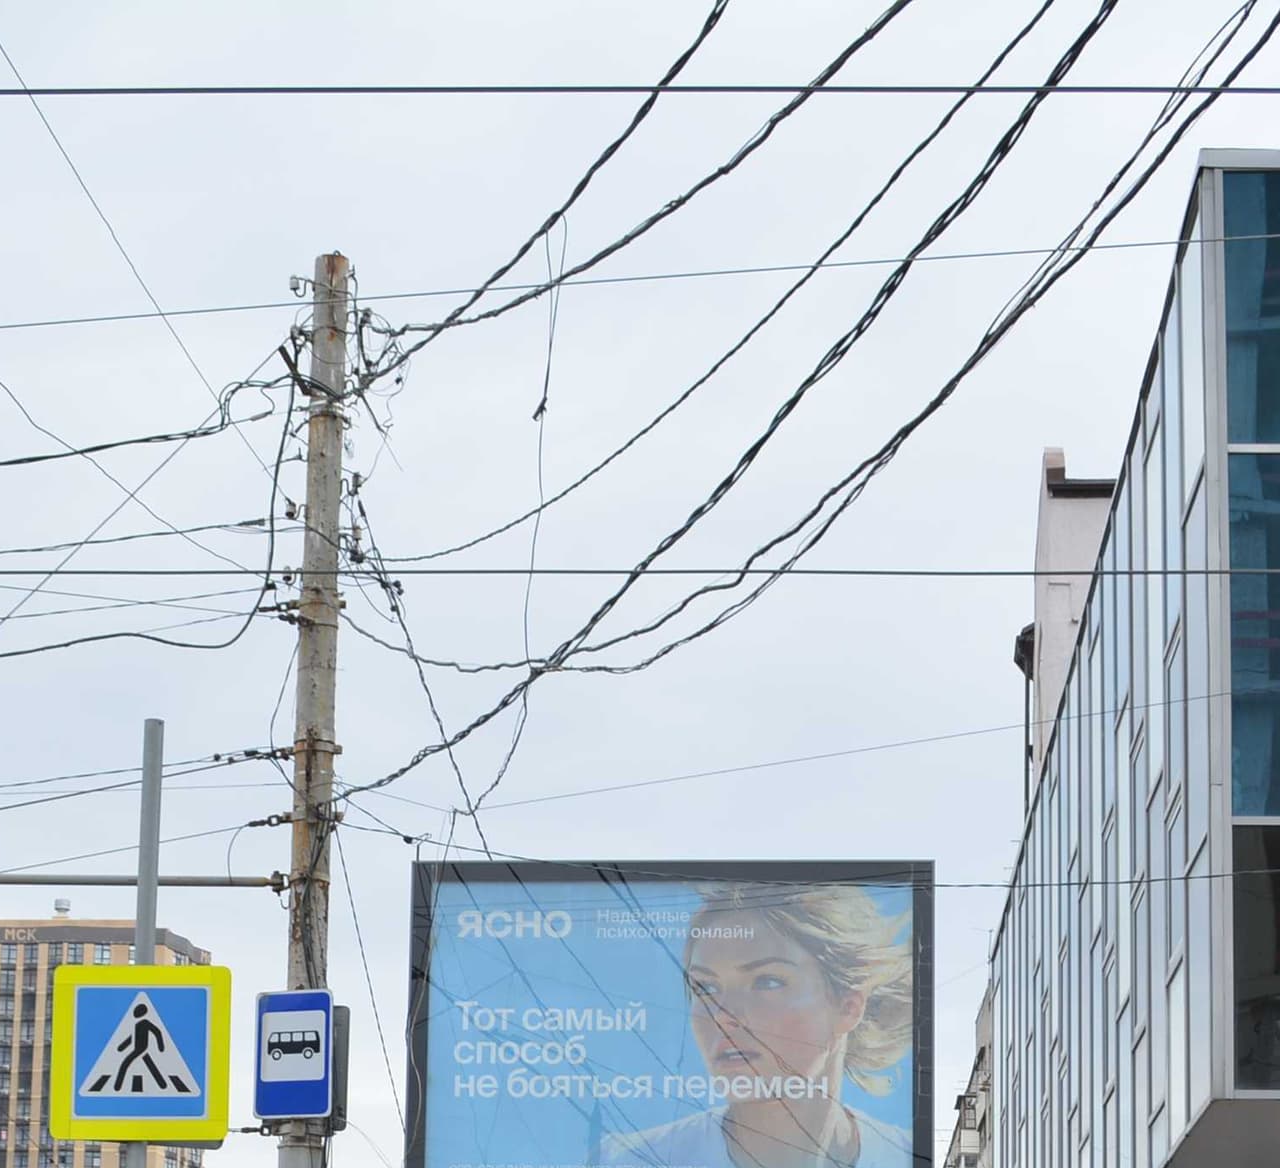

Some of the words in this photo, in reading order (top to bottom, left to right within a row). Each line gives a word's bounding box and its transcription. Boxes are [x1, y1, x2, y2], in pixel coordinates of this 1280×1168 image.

[456, 909, 572, 939] ЯСНО
[690, 925, 755, 939] онлайн
[455, 1001, 516, 1031] Тот
[522, 1001, 648, 1032] самый
[454, 1035, 587, 1064] способ
[454, 1074, 498, 1098] не
[507, 1068, 654, 1098] бояться
[663, 1074, 829, 1104] перемен
